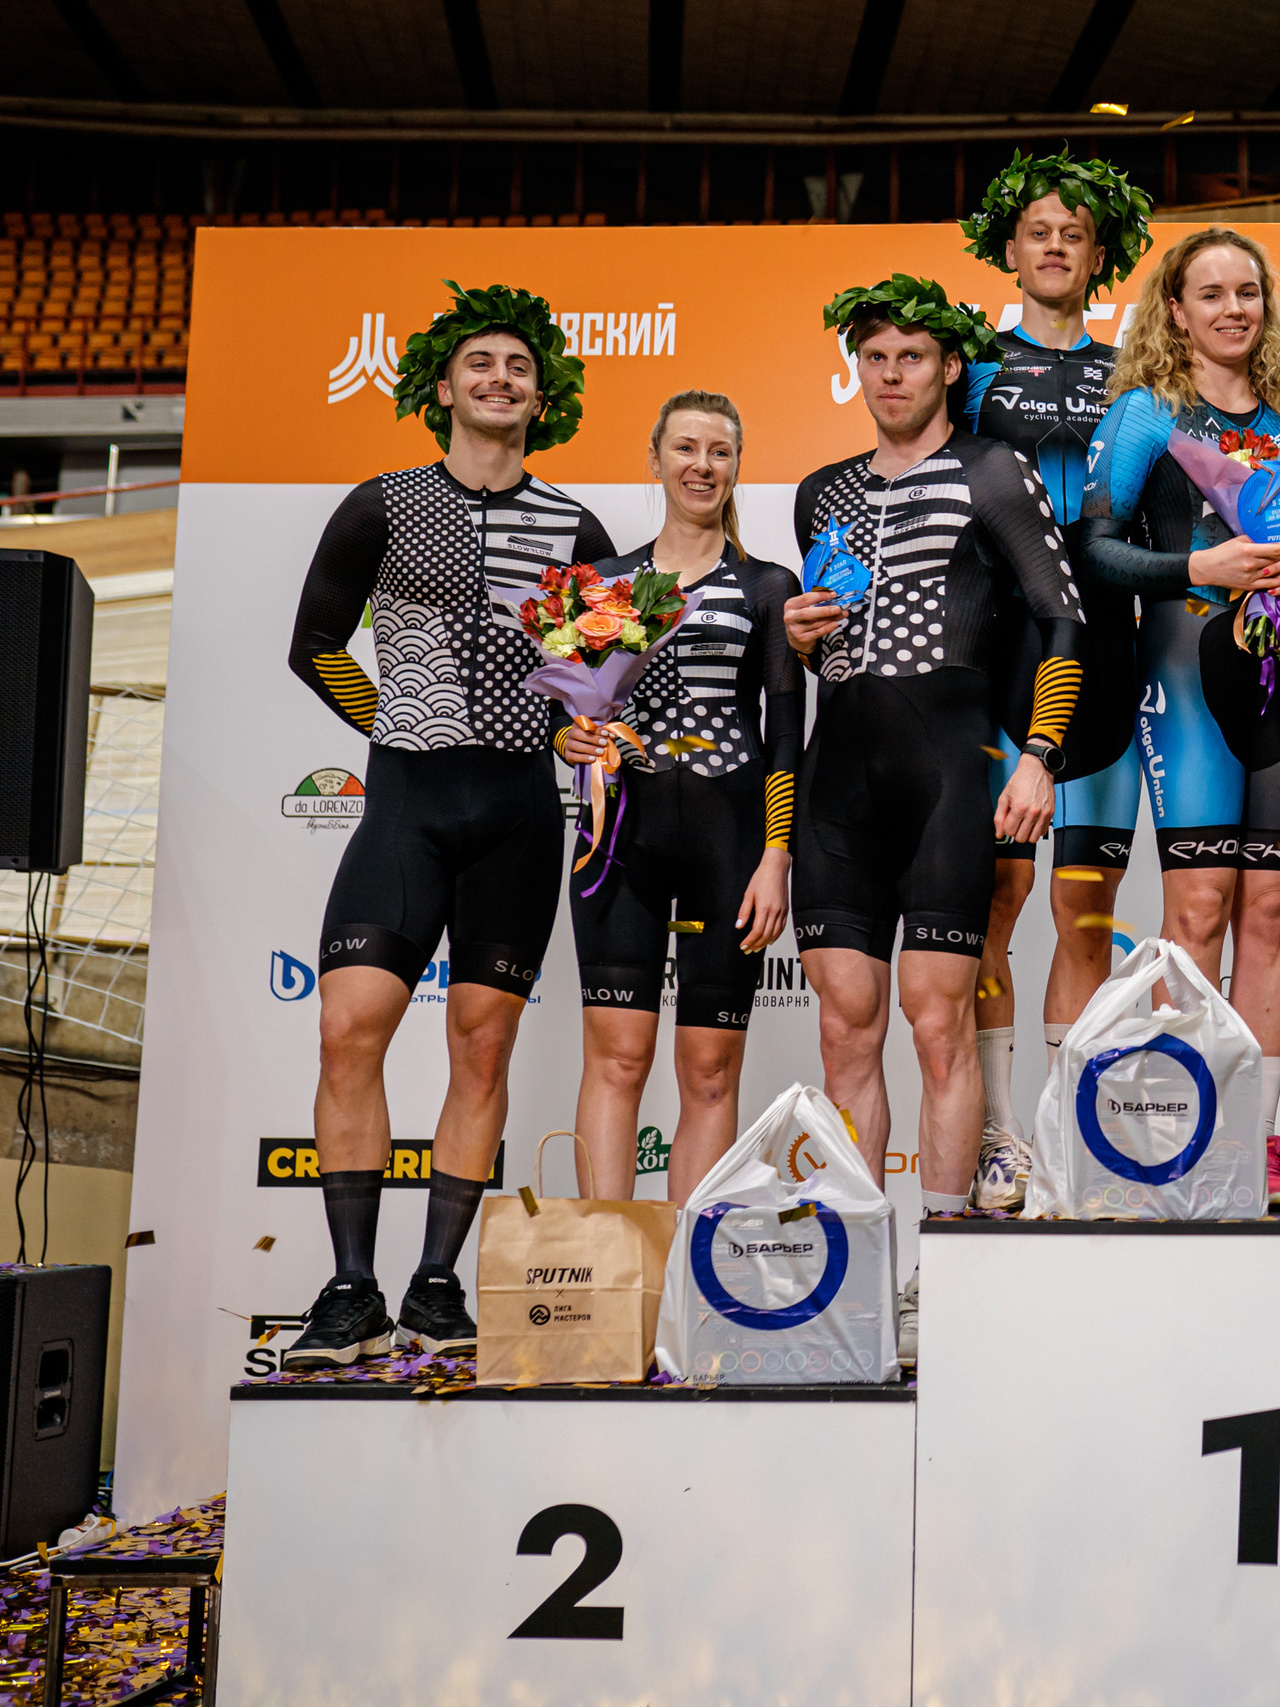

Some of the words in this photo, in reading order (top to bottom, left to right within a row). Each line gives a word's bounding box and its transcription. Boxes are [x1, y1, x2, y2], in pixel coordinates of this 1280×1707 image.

[991, 393, 1059, 413] Volga
[1065, 396, 1109, 414] Unio
[1024, 413, 1060, 422] cycling
[1066, 415, 1101, 424] academ
[294, 800, 308, 813] da
[313, 800, 364, 813] LORENZO
[494, 959, 534, 982] SLO
[755, 996, 810, 1008] ВОВАРНЯ
[717, 1011, 748, 1024] SLO
[1123, 1102, 1189, 1112] БАРЬЕР
[746, 1243, 814, 1254] БАРЬЕР
[526, 1267, 594, 1285] SPUTNIK
[554, 1305, 572, 1313] ЛИГА
[554, 1314, 592, 1322] МАСТЕРОВ
[508, 1504, 624, 1639] 2
